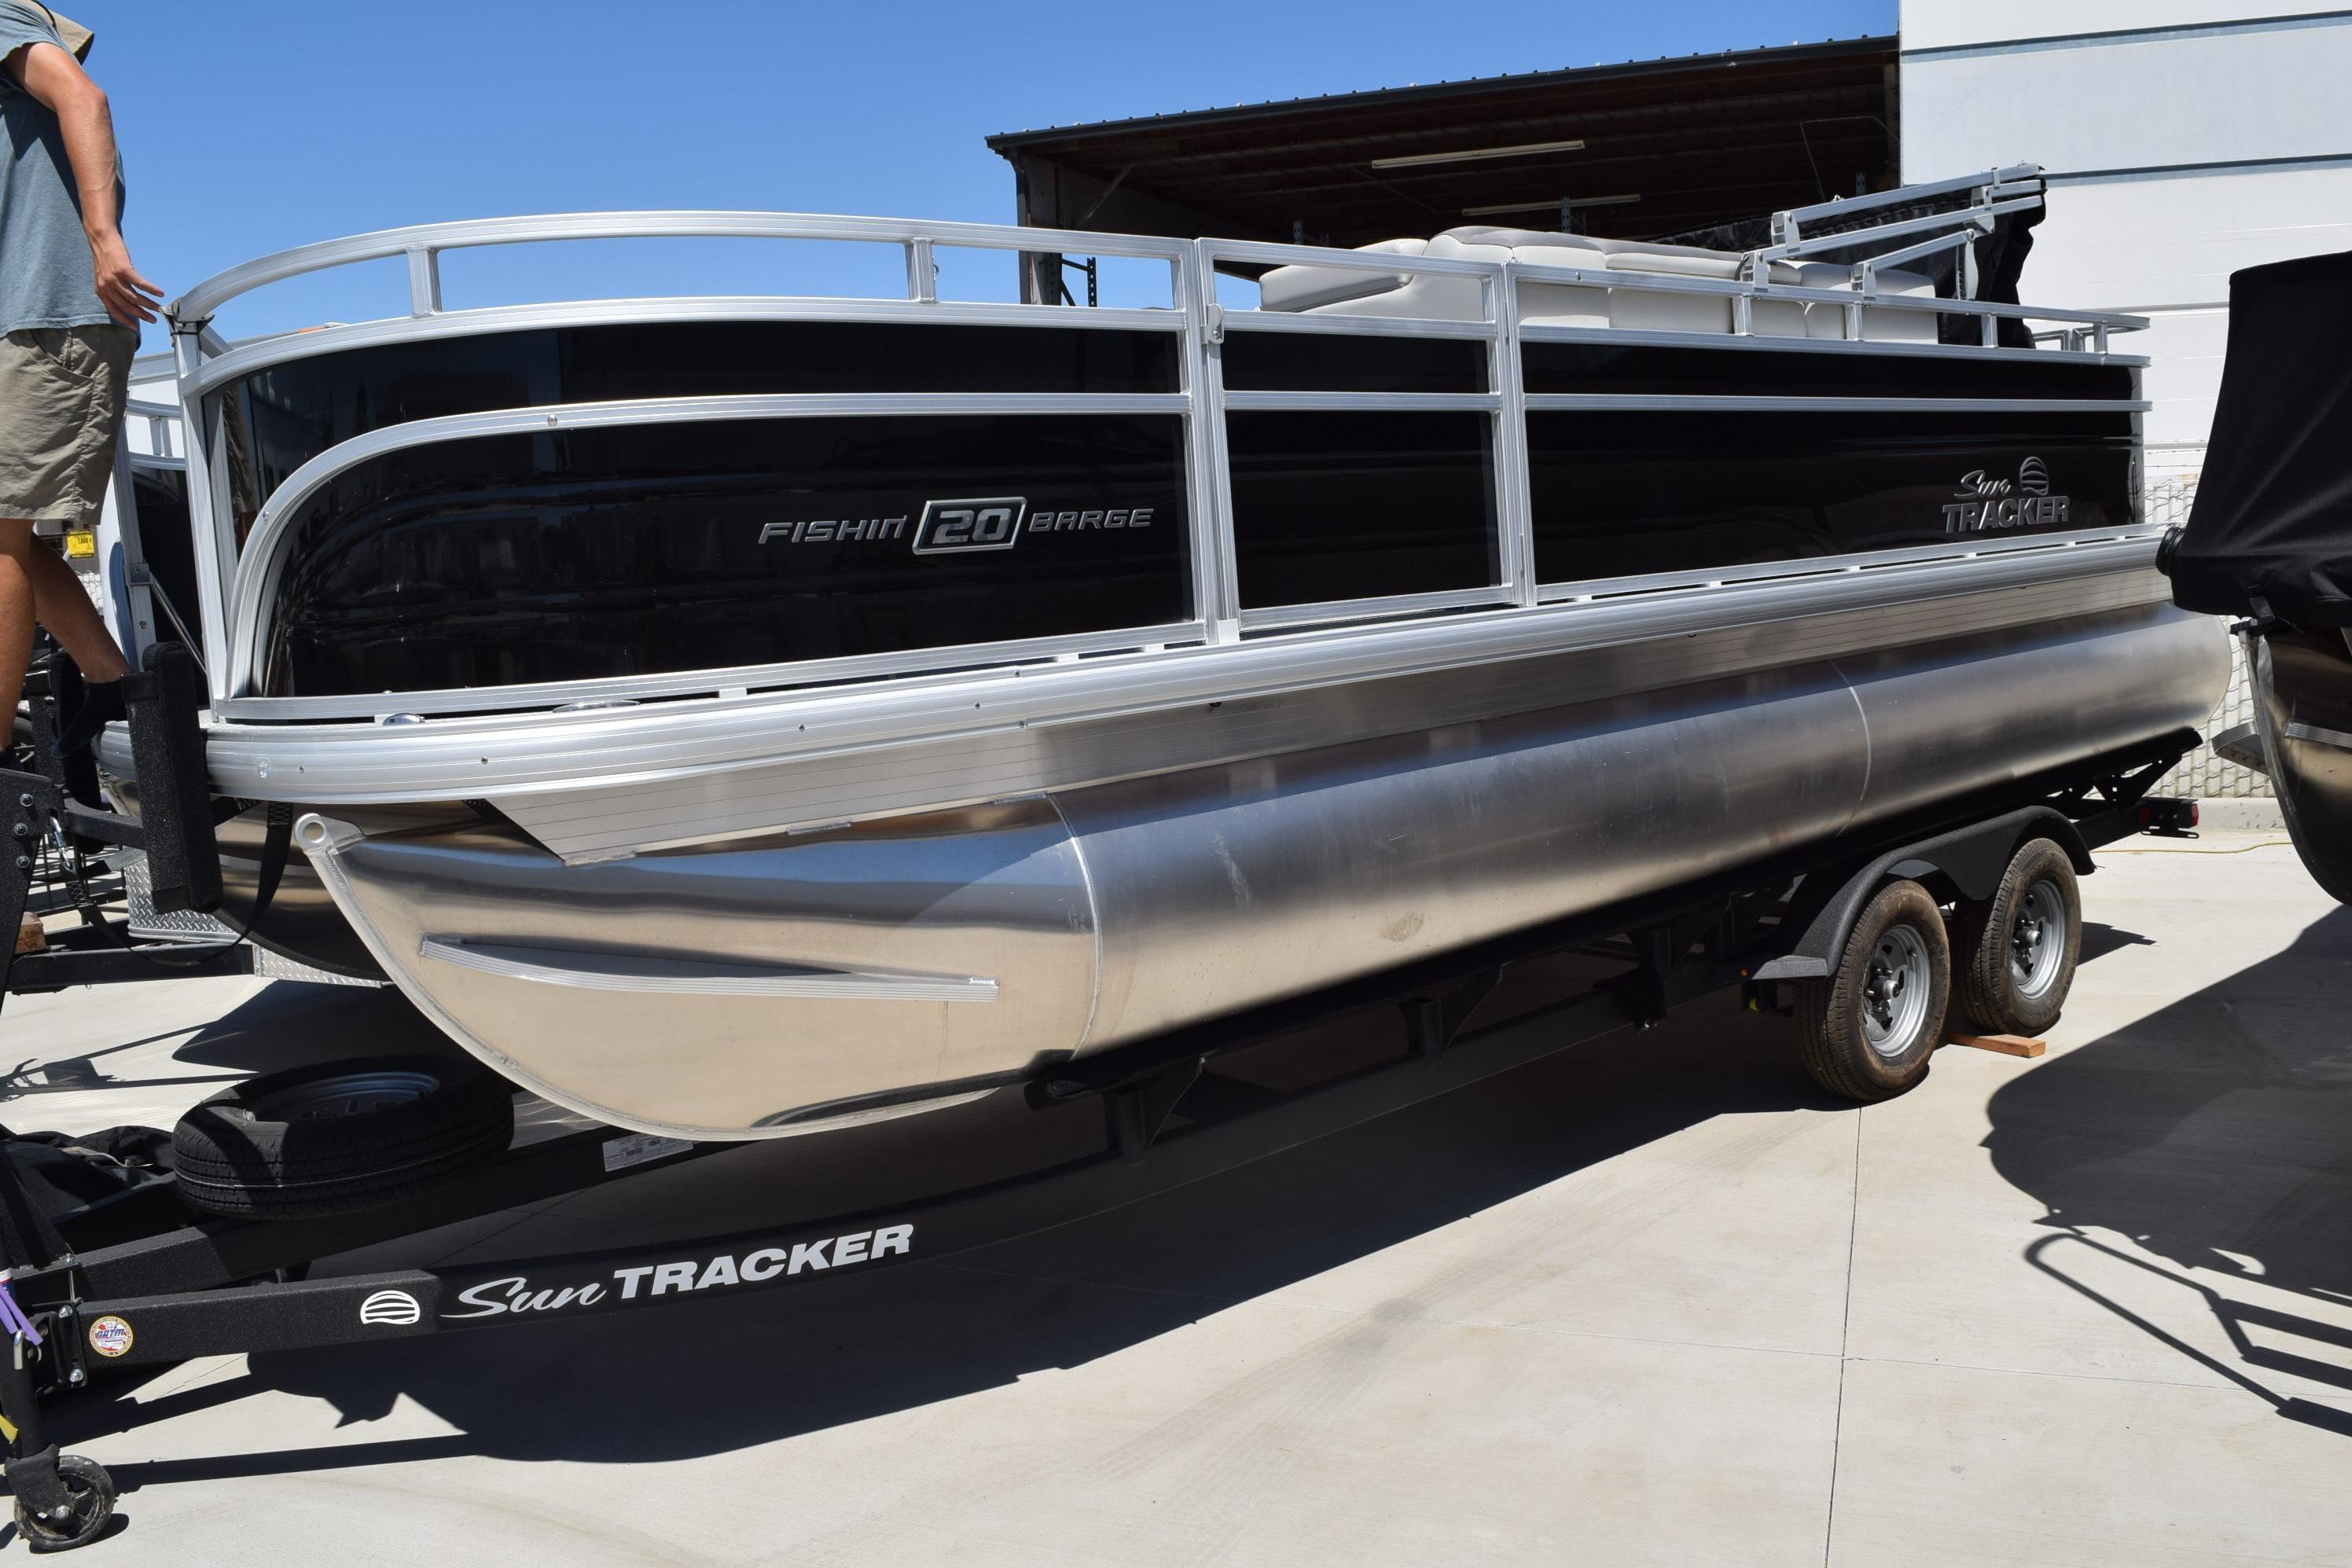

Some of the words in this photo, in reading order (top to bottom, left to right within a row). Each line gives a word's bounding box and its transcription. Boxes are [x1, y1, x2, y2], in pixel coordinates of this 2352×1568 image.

[1954, 469, 2012, 499] Sun
[932, 508, 1012, 545] 20
[1028, 508, 1155, 533] BARGE
[1942, 495, 2070, 534] TRACKER
[439, 1276, 607, 1319] Sun
[613, 1223, 914, 1299] TRACKER
